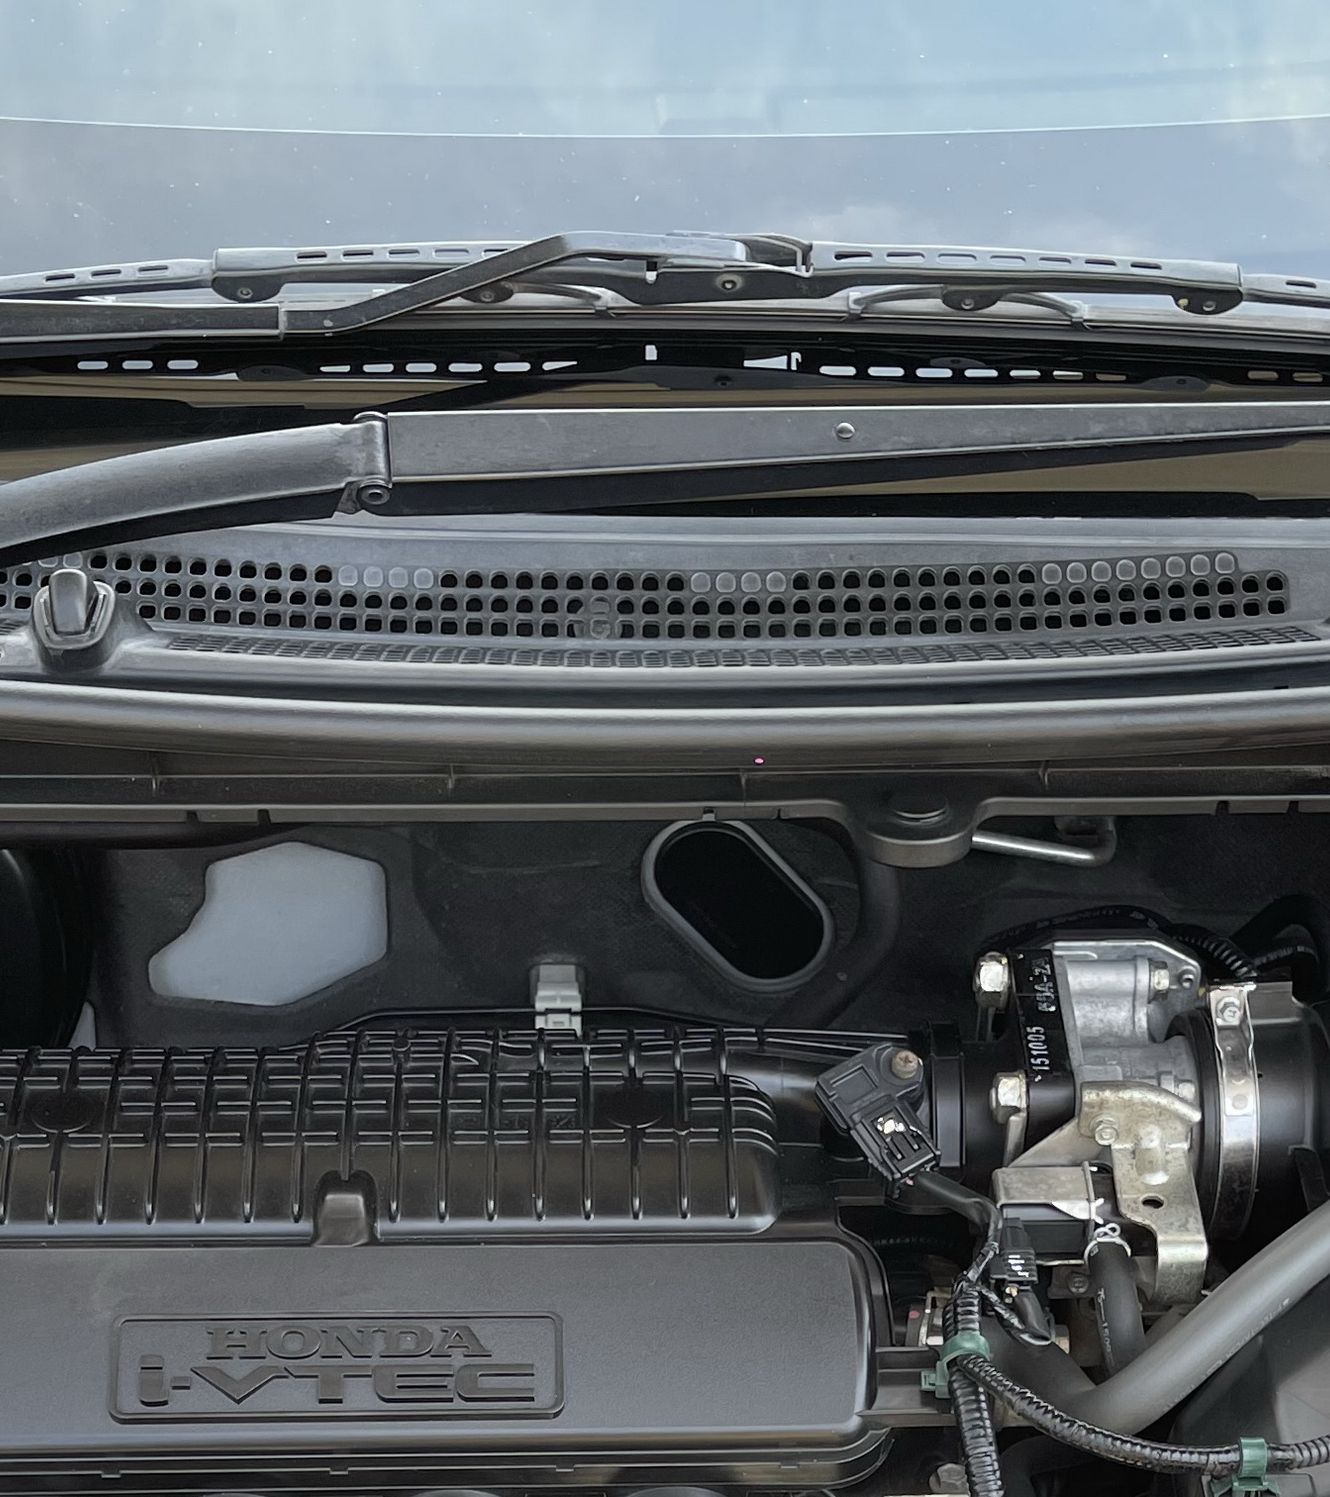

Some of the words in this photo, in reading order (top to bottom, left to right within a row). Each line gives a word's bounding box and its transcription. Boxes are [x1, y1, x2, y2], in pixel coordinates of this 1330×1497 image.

[1026, 1026, 1051, 1071] 151005
[206, 1325, 492, 1360] HONDA
[139, 1354, 535, 1407] i-VTEC
